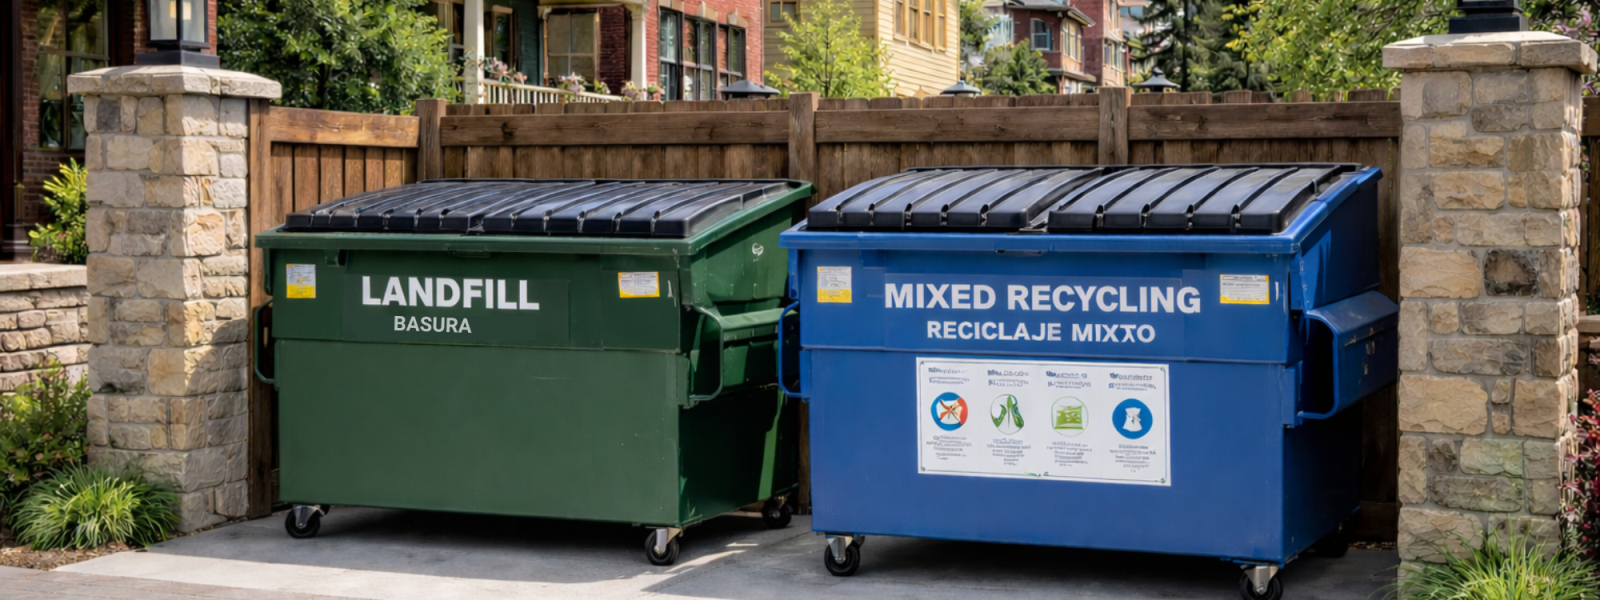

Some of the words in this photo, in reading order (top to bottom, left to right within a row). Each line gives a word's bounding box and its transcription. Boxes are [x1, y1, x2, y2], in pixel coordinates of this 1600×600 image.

[362, 275, 540, 310] LANDFILL
[884, 282, 997, 309] MIXED
[1008, 284, 1201, 314] RECYCLING
[394, 315, 472, 334] BASURA
[927, 320, 1062, 341] RECICLAJE
